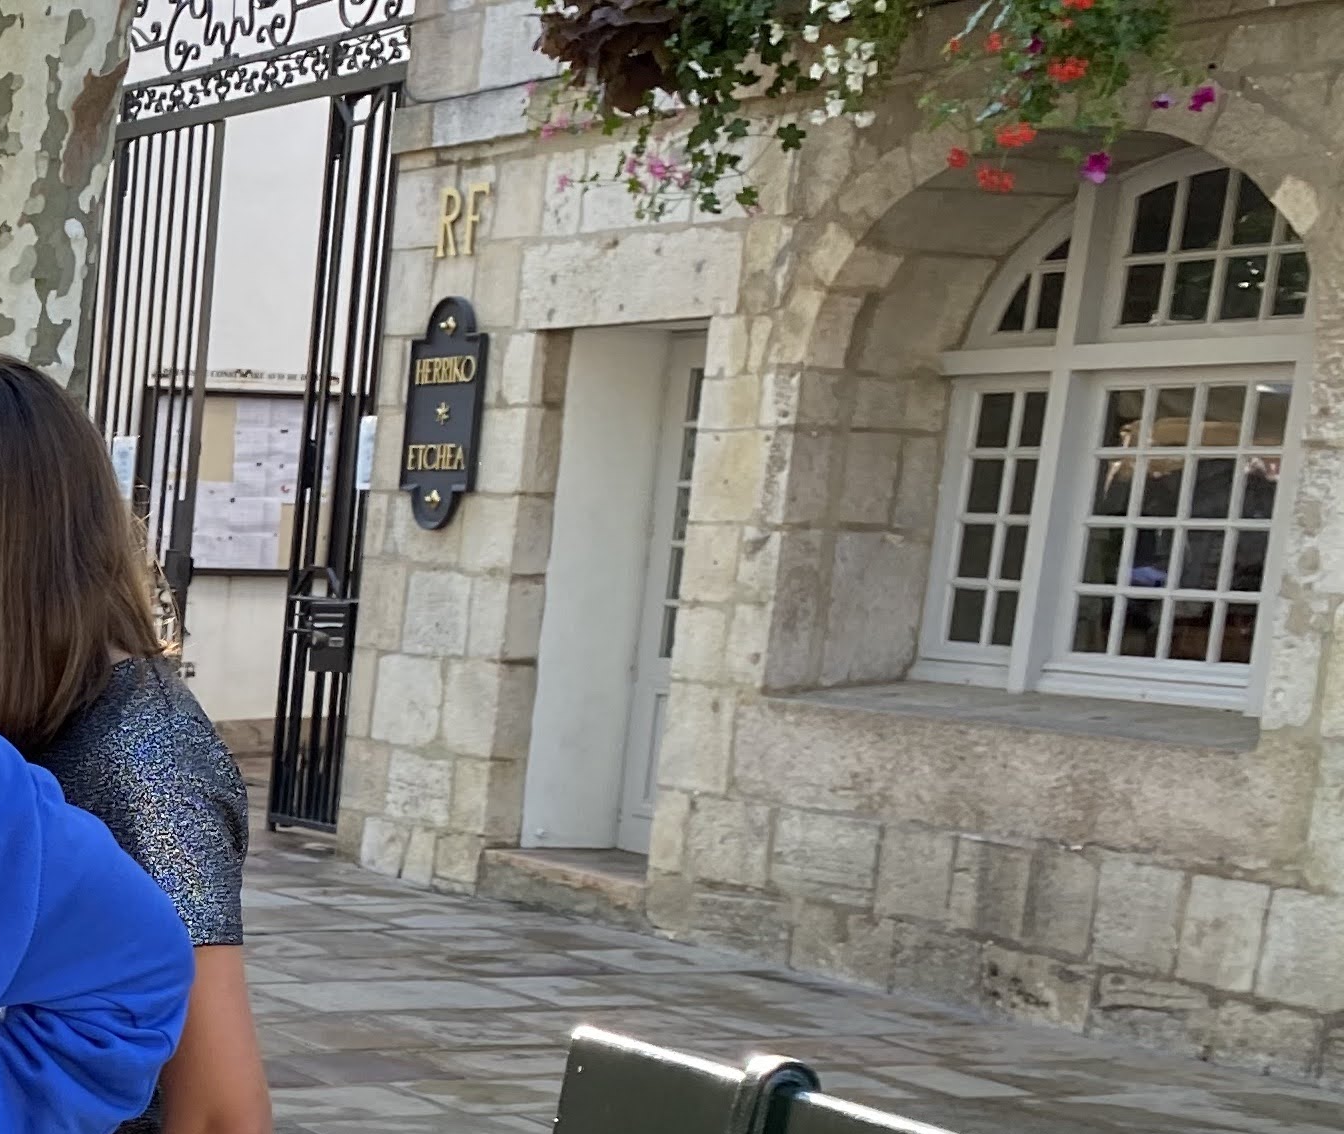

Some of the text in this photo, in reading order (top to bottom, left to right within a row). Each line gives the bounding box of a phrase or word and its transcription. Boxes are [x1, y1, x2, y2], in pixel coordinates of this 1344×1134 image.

[435, 183, 490, 257] RF
[415, 355, 476, 385] HERRIKO
[407, 443, 465, 471] ETCHEA
